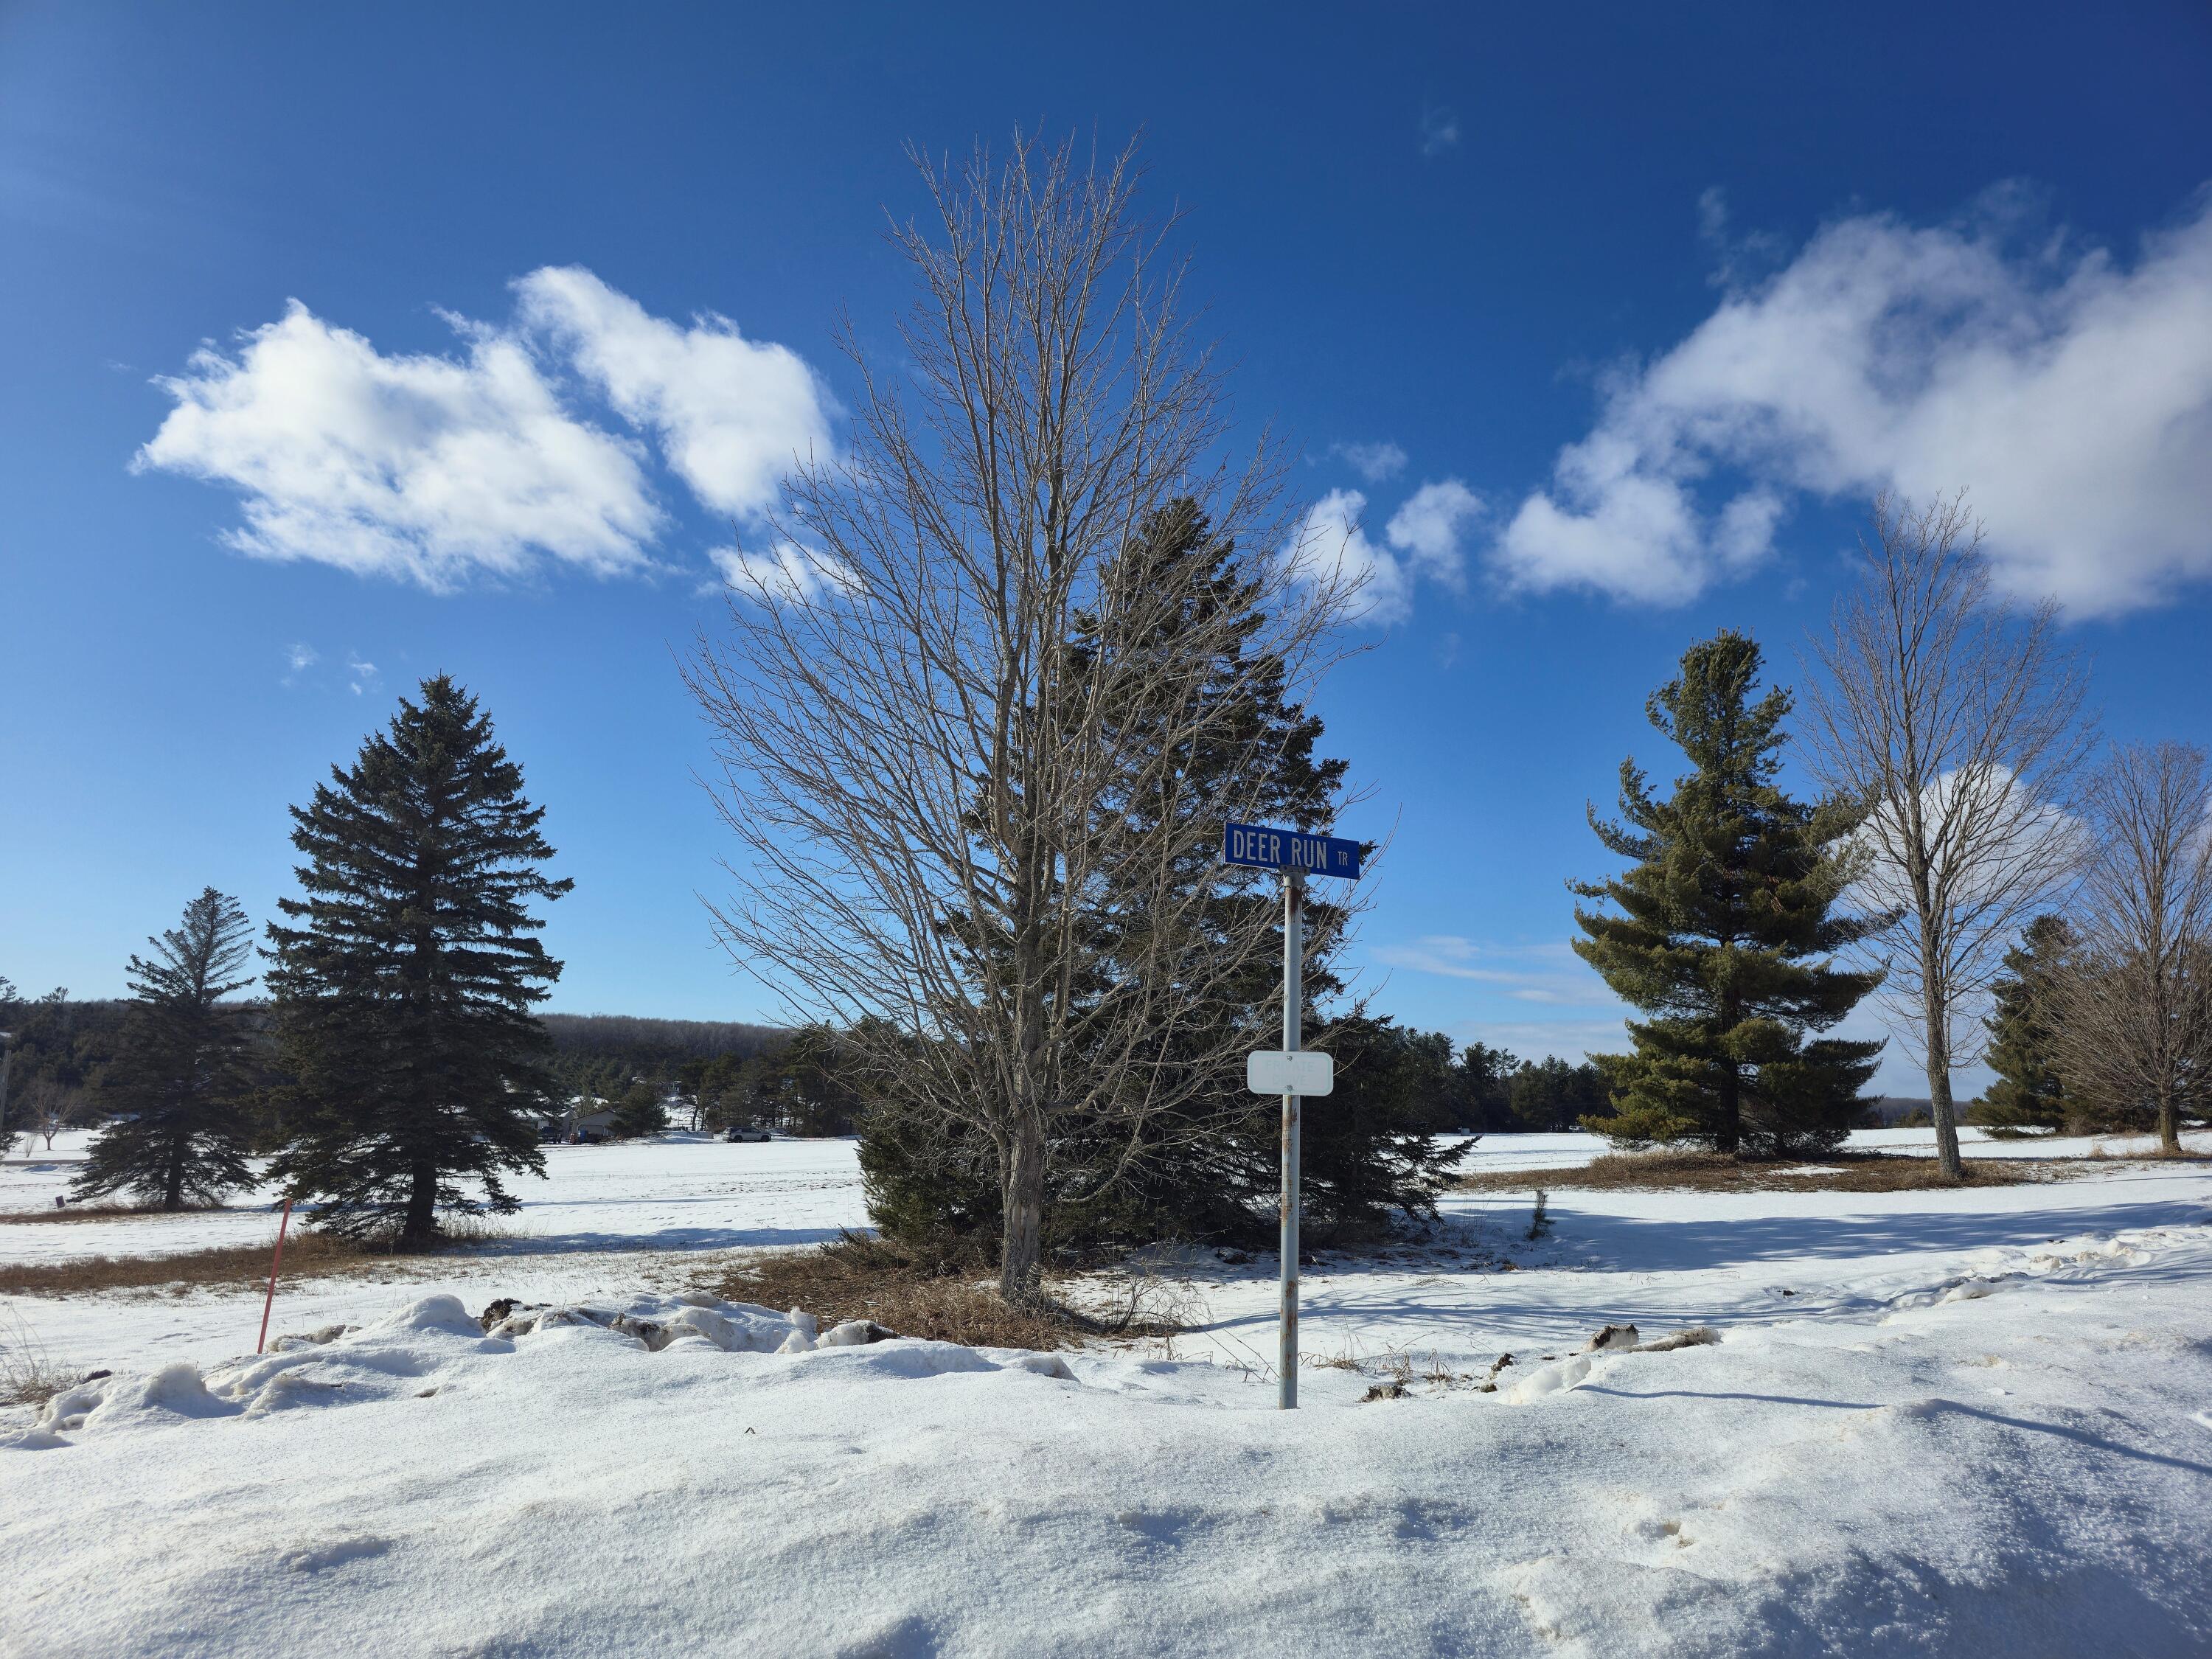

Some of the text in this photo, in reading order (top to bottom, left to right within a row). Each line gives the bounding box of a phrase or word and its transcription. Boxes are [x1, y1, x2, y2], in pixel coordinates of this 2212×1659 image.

[1234, 830, 1348, 869] DEER RUN TR
